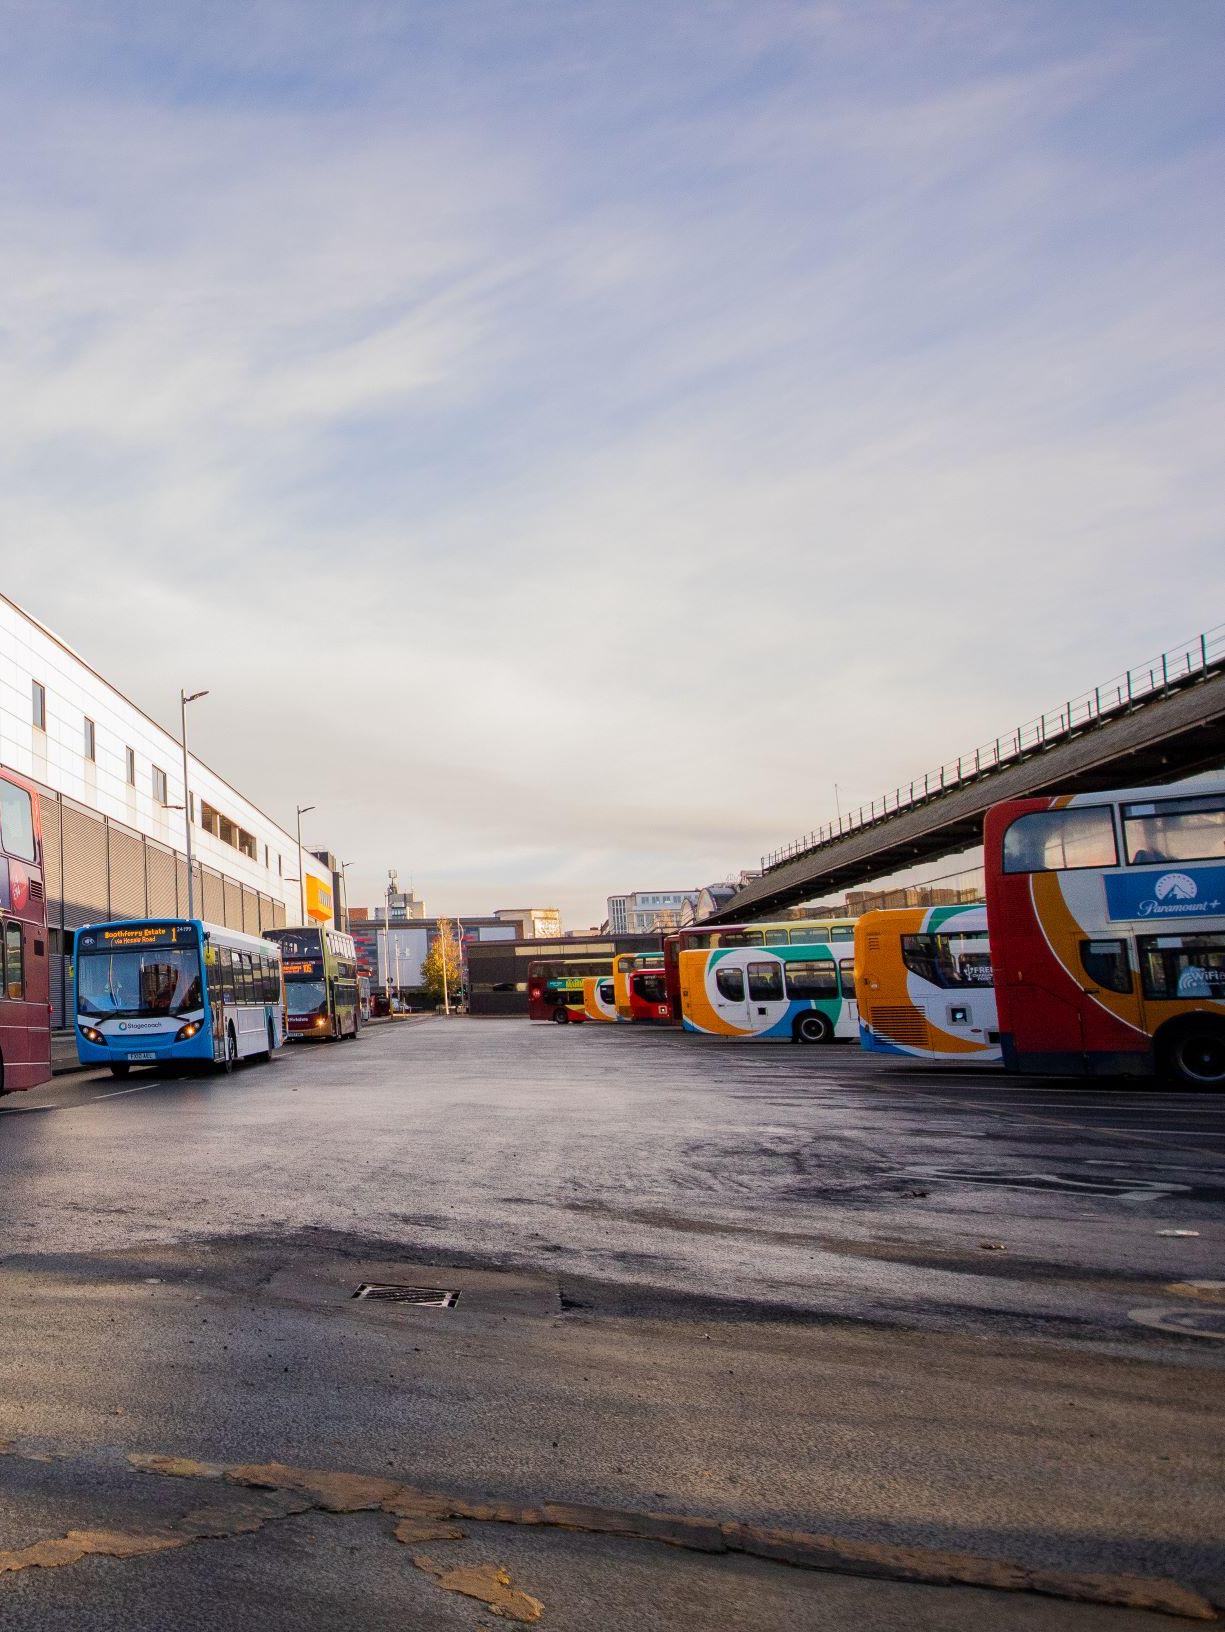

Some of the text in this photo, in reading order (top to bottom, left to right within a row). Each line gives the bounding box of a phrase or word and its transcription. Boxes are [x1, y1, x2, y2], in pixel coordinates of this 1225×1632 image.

[104, 927, 177, 942] Boothferry Estate 1
[127, 1022, 162, 1030] Stagecoach
